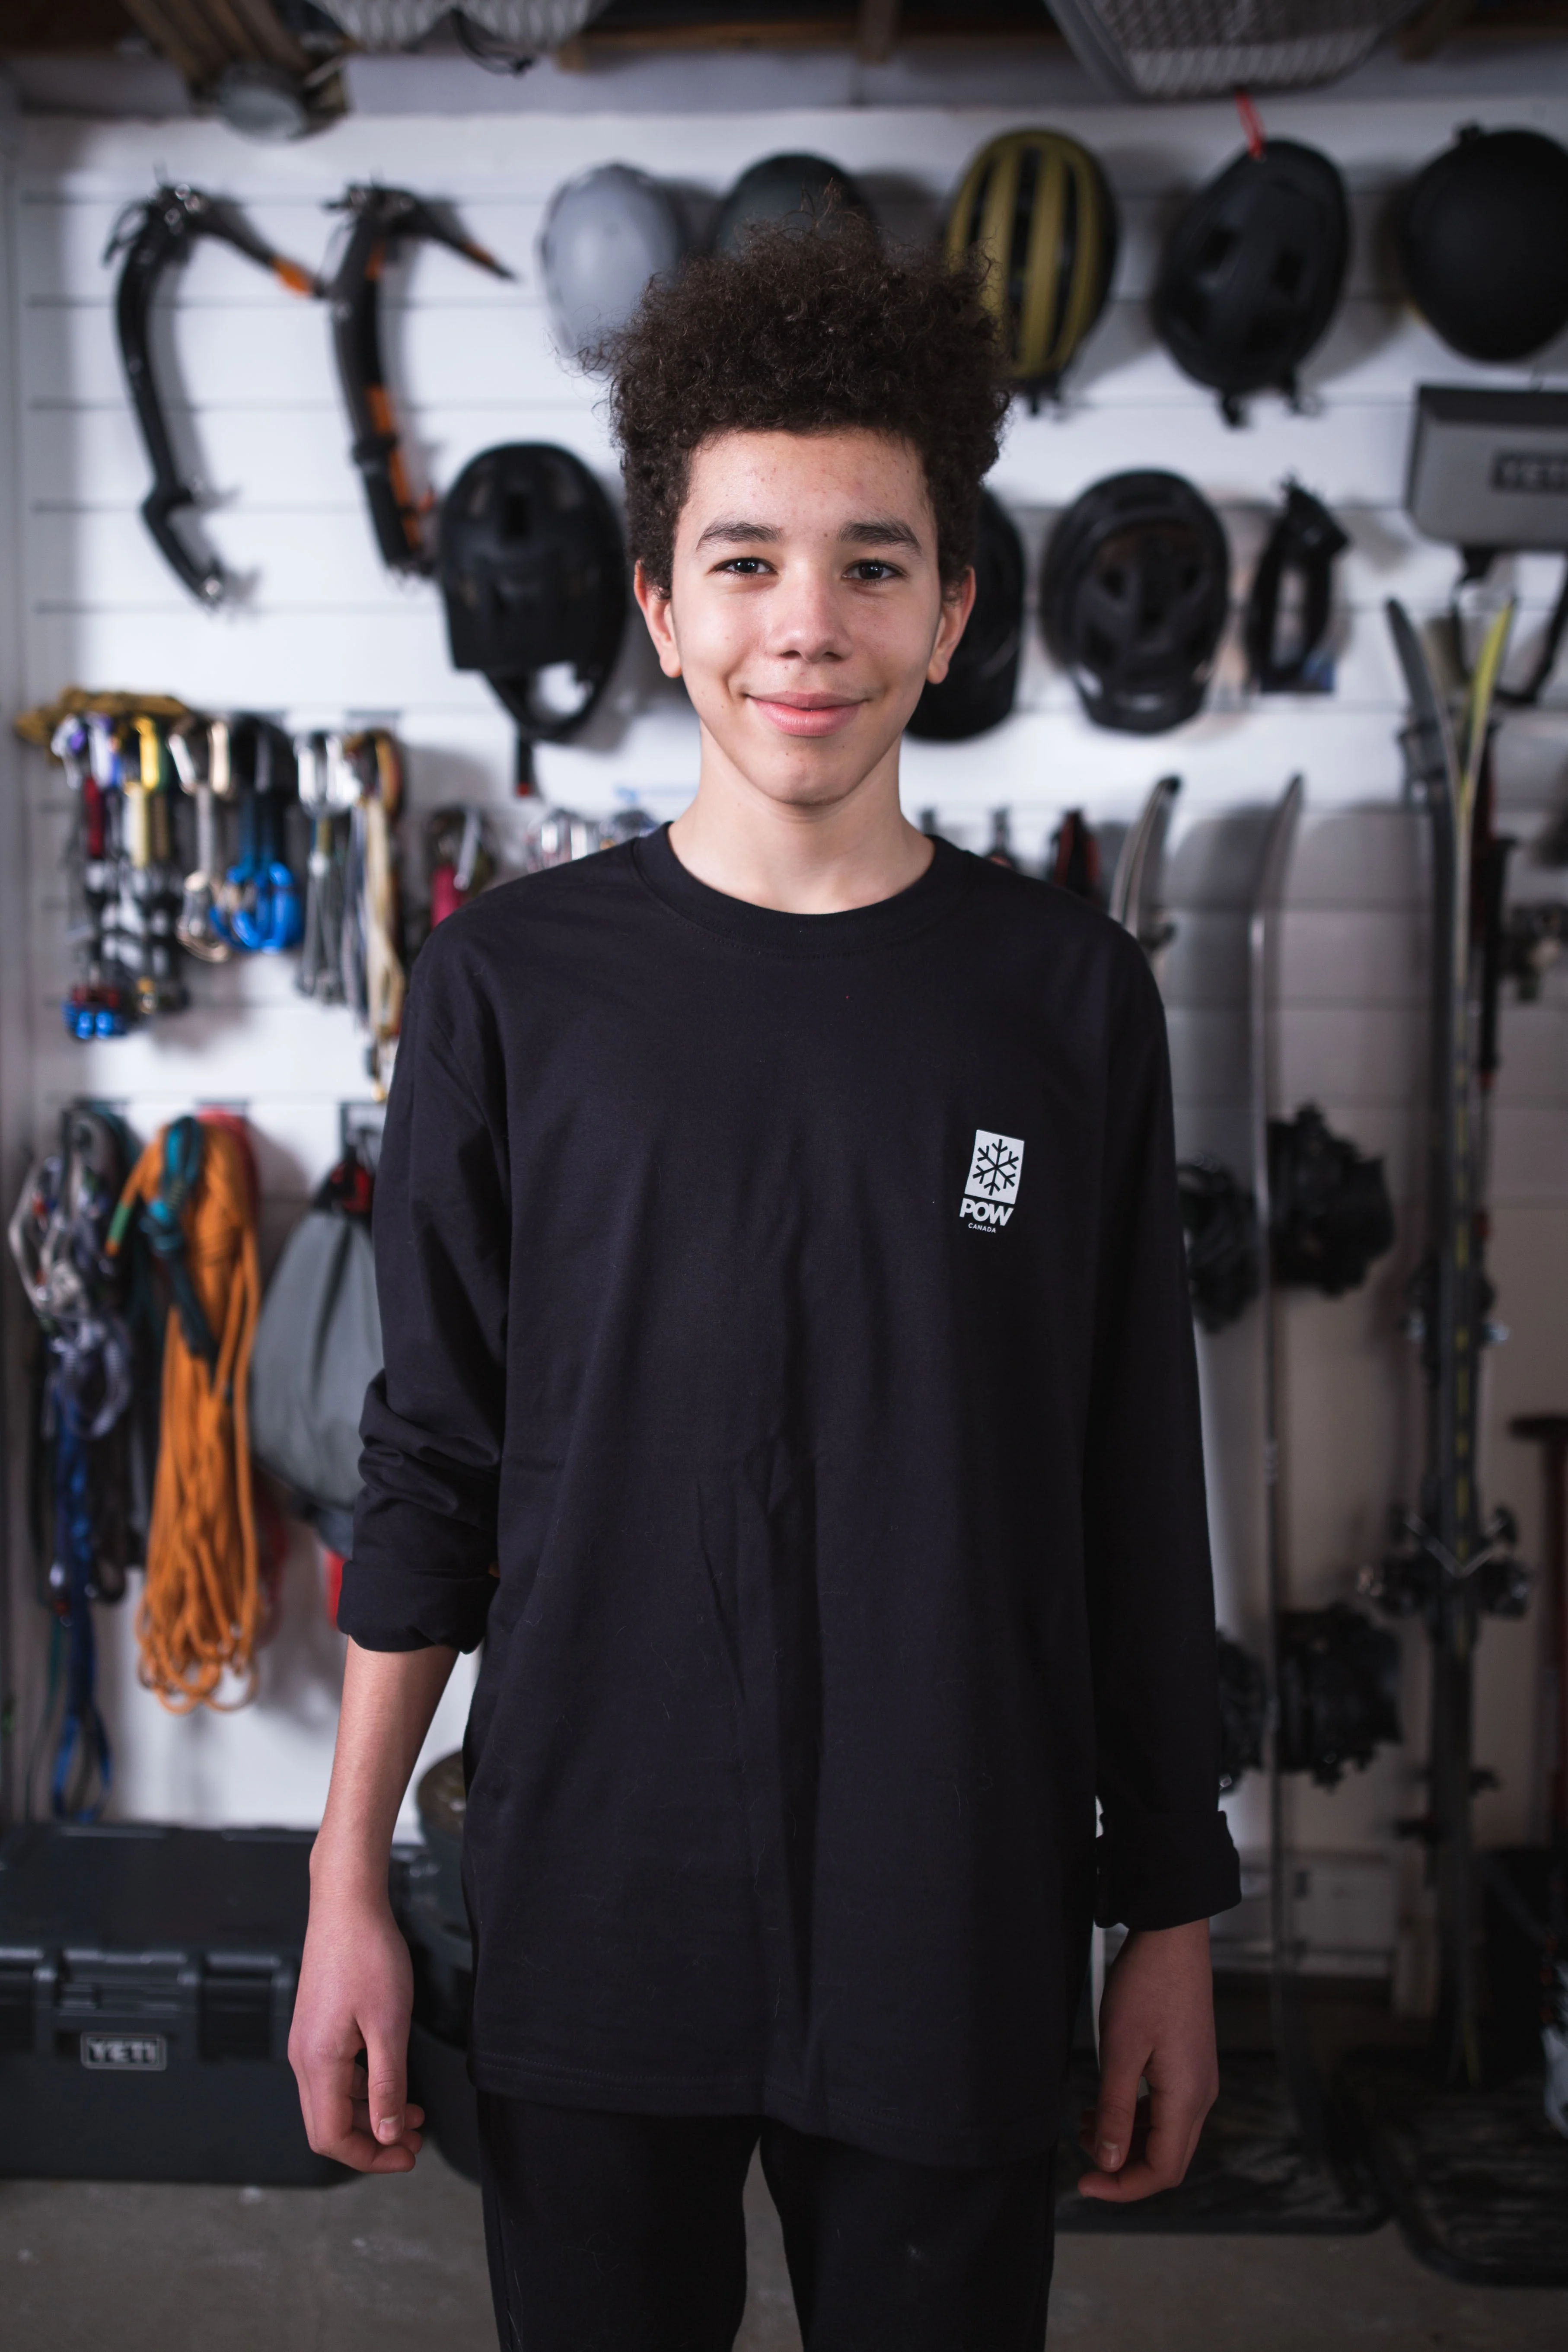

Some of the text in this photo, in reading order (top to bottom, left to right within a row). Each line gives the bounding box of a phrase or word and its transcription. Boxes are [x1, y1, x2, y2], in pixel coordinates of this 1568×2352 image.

[959, 1198, 1014, 1226] POW
[968, 1222, 996, 1233] CANADA
[88, 2040, 156, 2063] YETI
